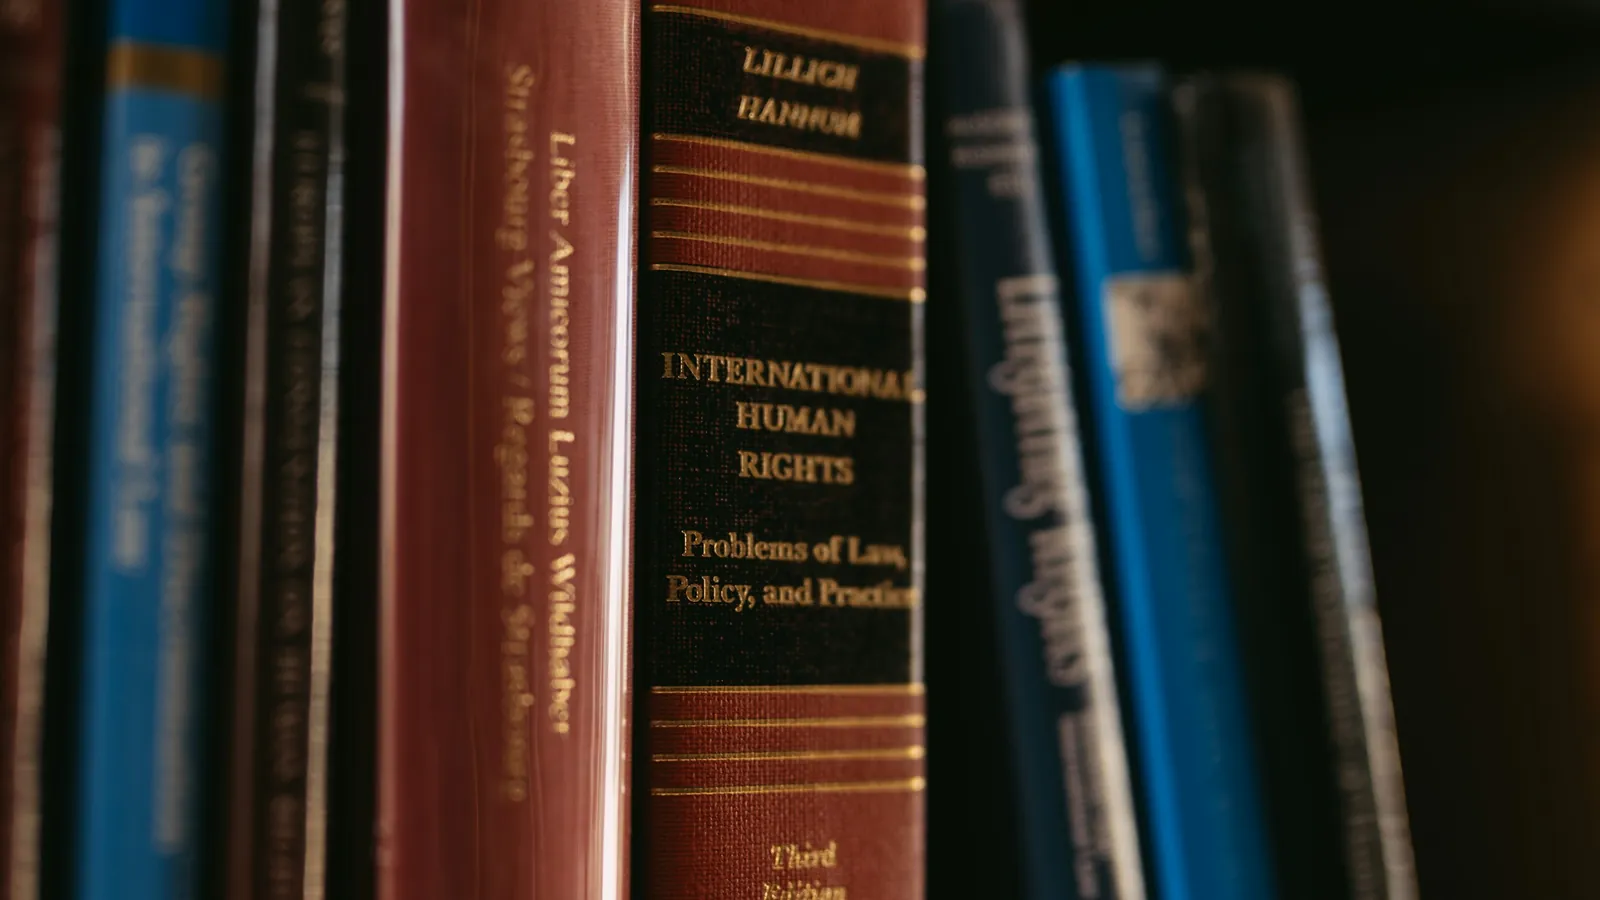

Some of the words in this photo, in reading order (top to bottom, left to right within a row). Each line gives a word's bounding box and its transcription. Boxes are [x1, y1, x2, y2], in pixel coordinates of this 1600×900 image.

[742, 46, 859, 92] LILLICH
[736, 95, 862, 139] HANNUM
[549, 131, 576, 226] Liber
[549, 230, 575, 418] Amicorum
[736, 400, 857, 438] HUMAN
[549, 430, 575, 545] Luzius
[737, 450, 856, 486] RIGHTS
[681, 529, 808, 562] Problems
[813, 535, 844, 563] of
[848, 536, 908, 571] Law,
[666, 575, 756, 612] Policy,
[763, 577, 814, 606] and
[549, 553, 577, 737] Wildhaber
[770, 840, 837, 870] Third
